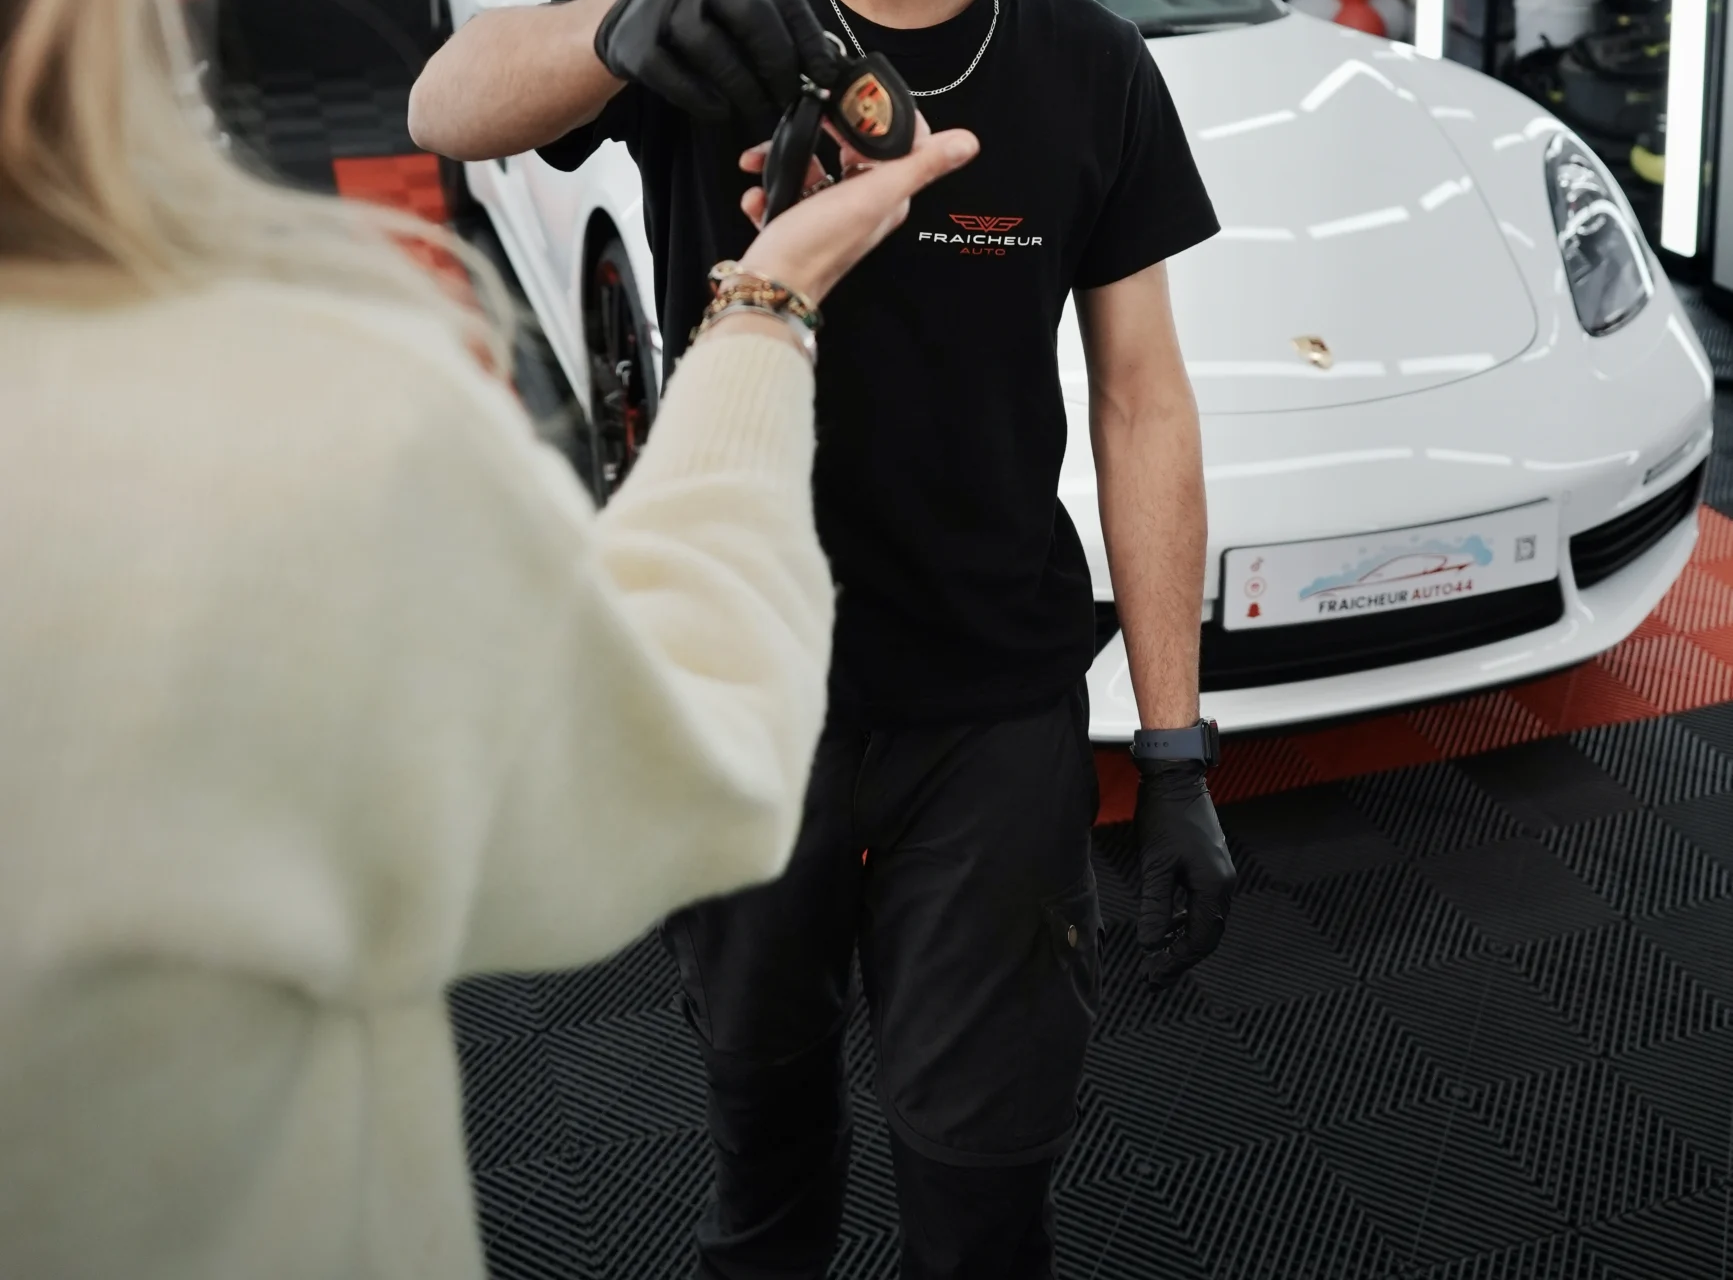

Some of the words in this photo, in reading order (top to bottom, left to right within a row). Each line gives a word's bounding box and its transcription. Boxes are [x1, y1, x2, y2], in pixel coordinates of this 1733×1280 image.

[918, 231, 1043, 246] FRAICHEUR
[959, 246, 1006, 256] AUTO
[1318, 590, 1409, 614] FRAICHEUR
[1411, 579, 1474, 601] AUTO44
